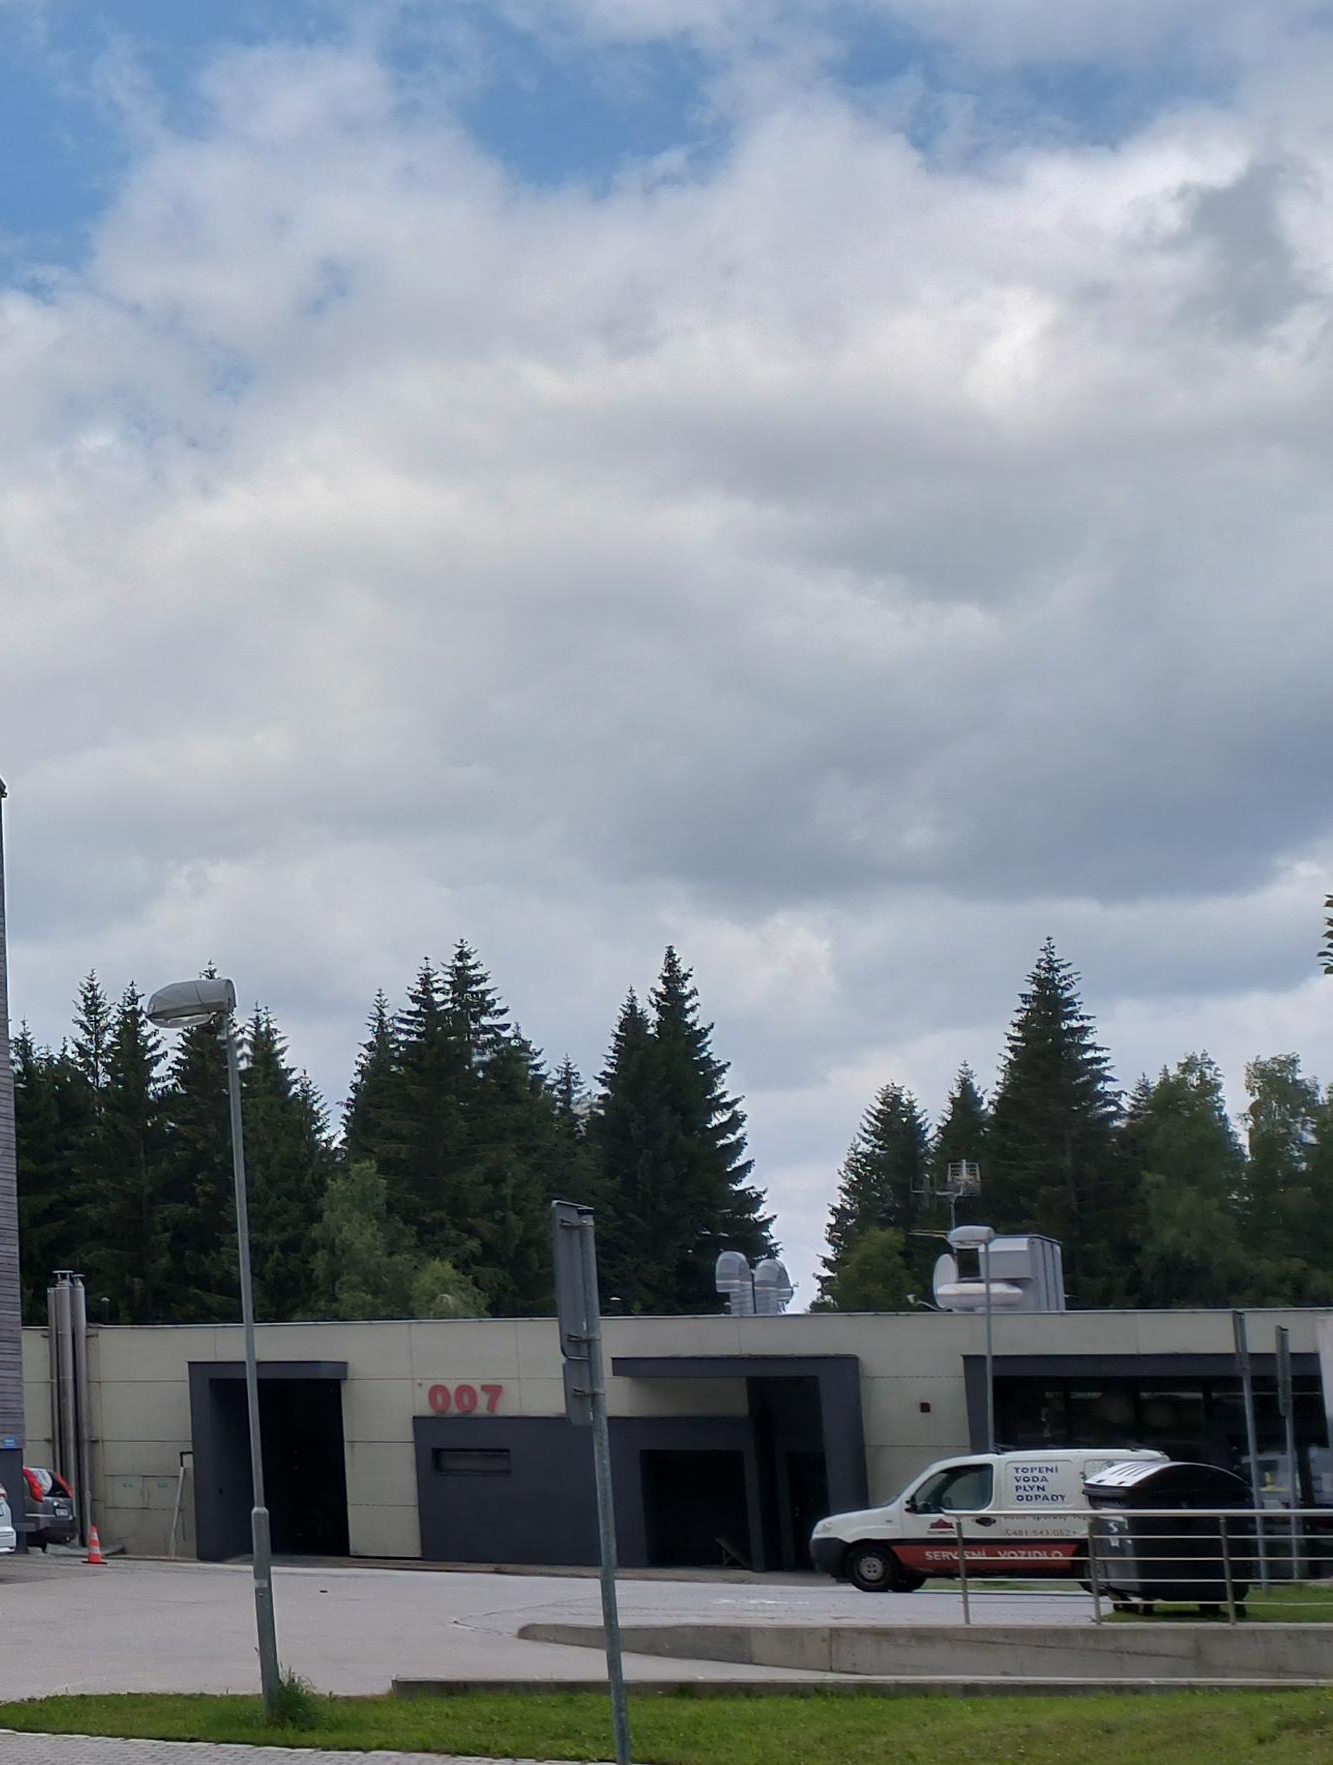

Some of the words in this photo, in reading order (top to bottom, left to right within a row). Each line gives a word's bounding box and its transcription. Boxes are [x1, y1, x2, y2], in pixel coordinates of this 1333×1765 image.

[428, 1384, 504, 1413] 007
[1014, 1465, 1059, 1474] TOPENÍ
[1014, 1475, 1049, 1483] VODA
[1016, 1494, 1066, 1502] ODPADY
[925, 1549, 986, 1560] SERVSNÍ
